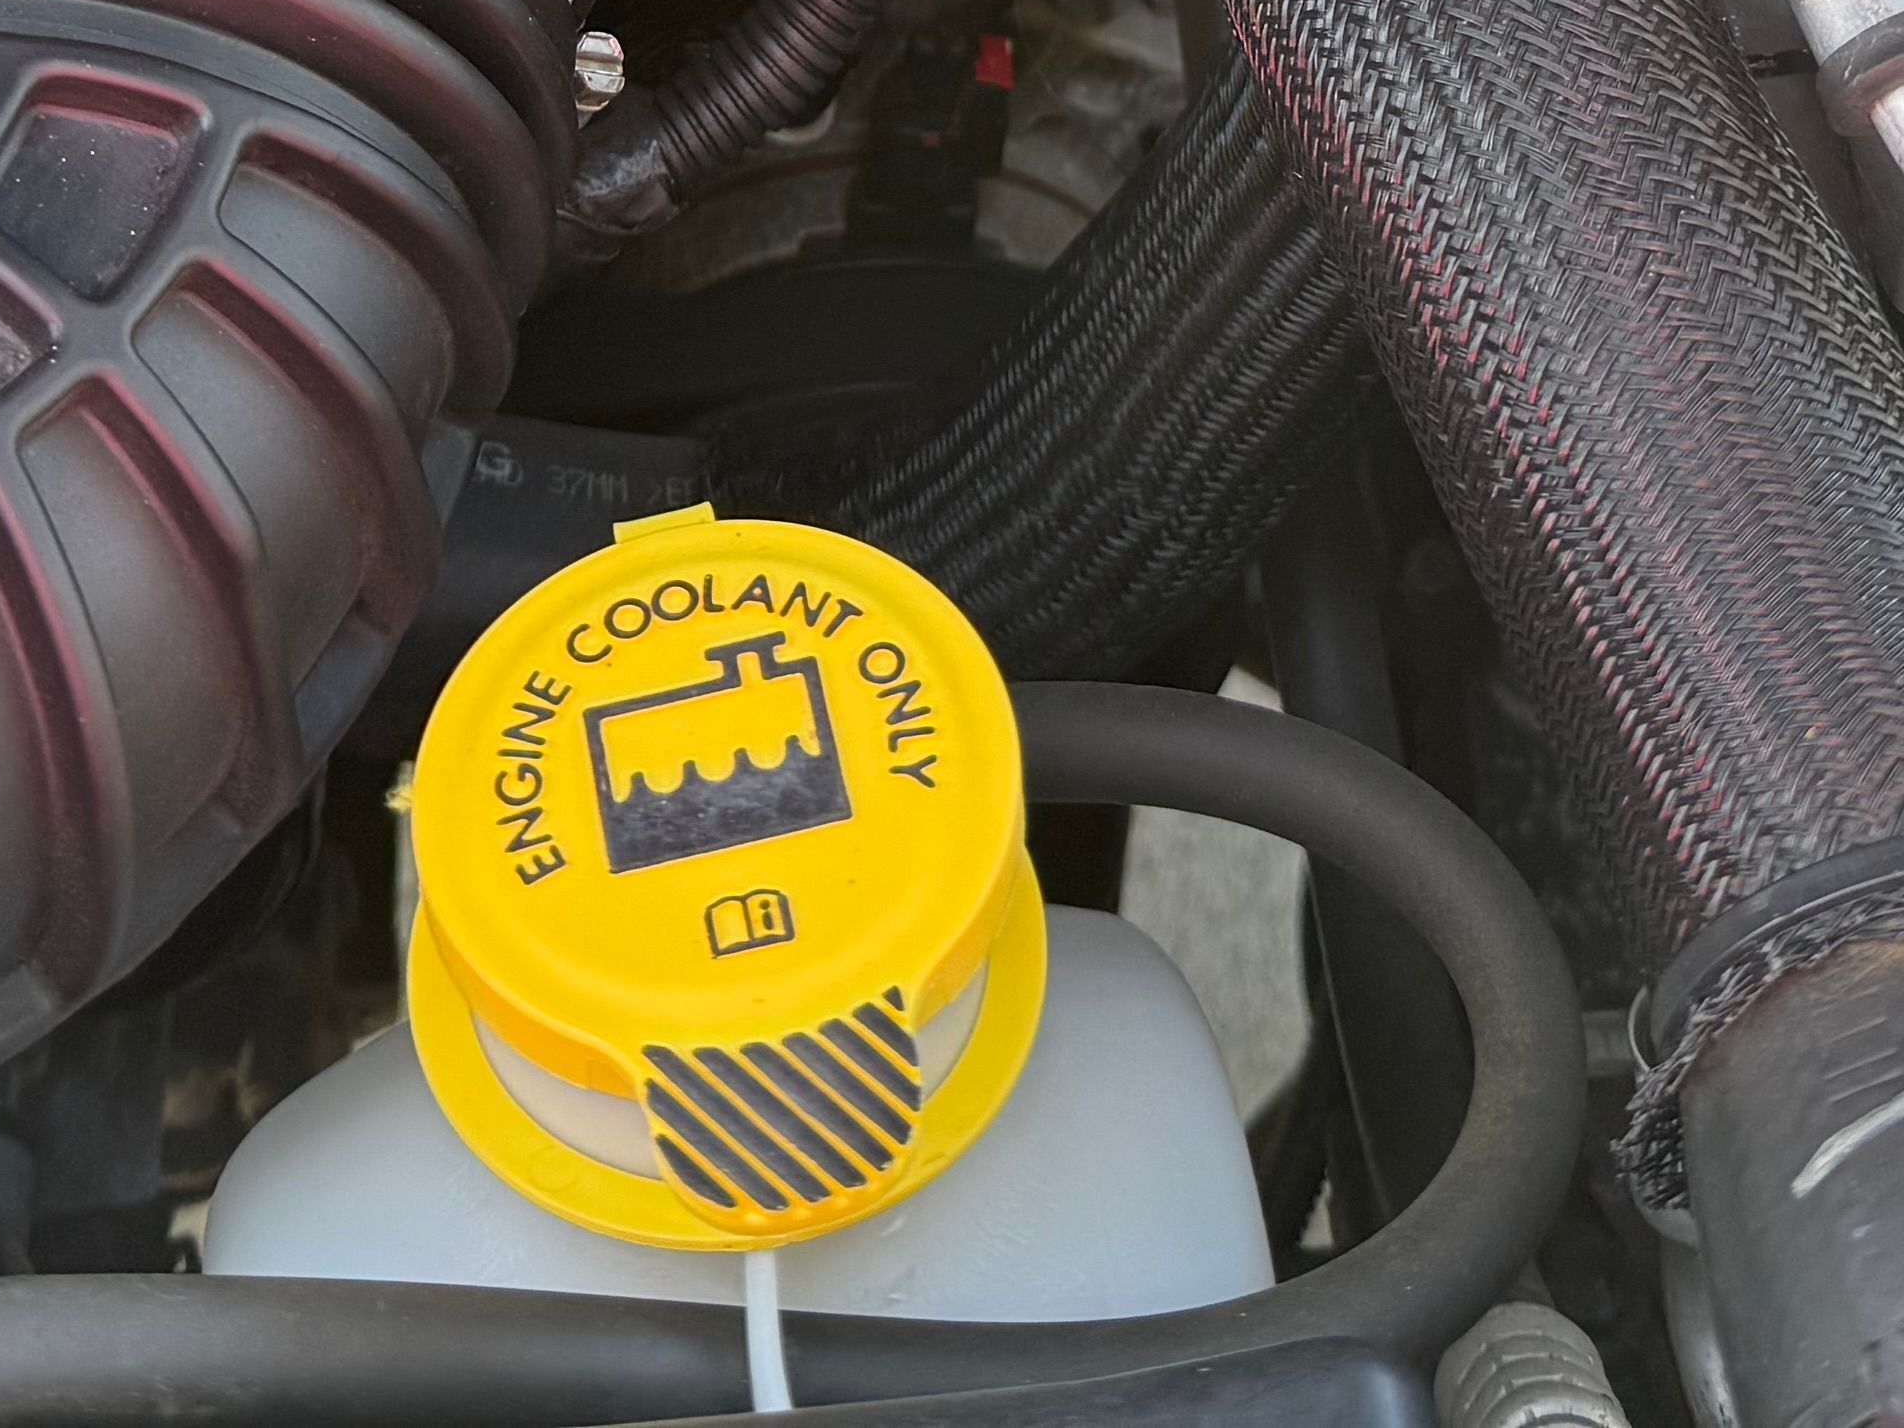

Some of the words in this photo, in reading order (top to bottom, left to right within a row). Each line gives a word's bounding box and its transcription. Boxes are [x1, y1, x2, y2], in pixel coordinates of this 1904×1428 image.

[496, 670, 571, 885] ENGINE
[567, 574, 864, 664] COOLANT
[858, 641, 937, 789] ONLY
